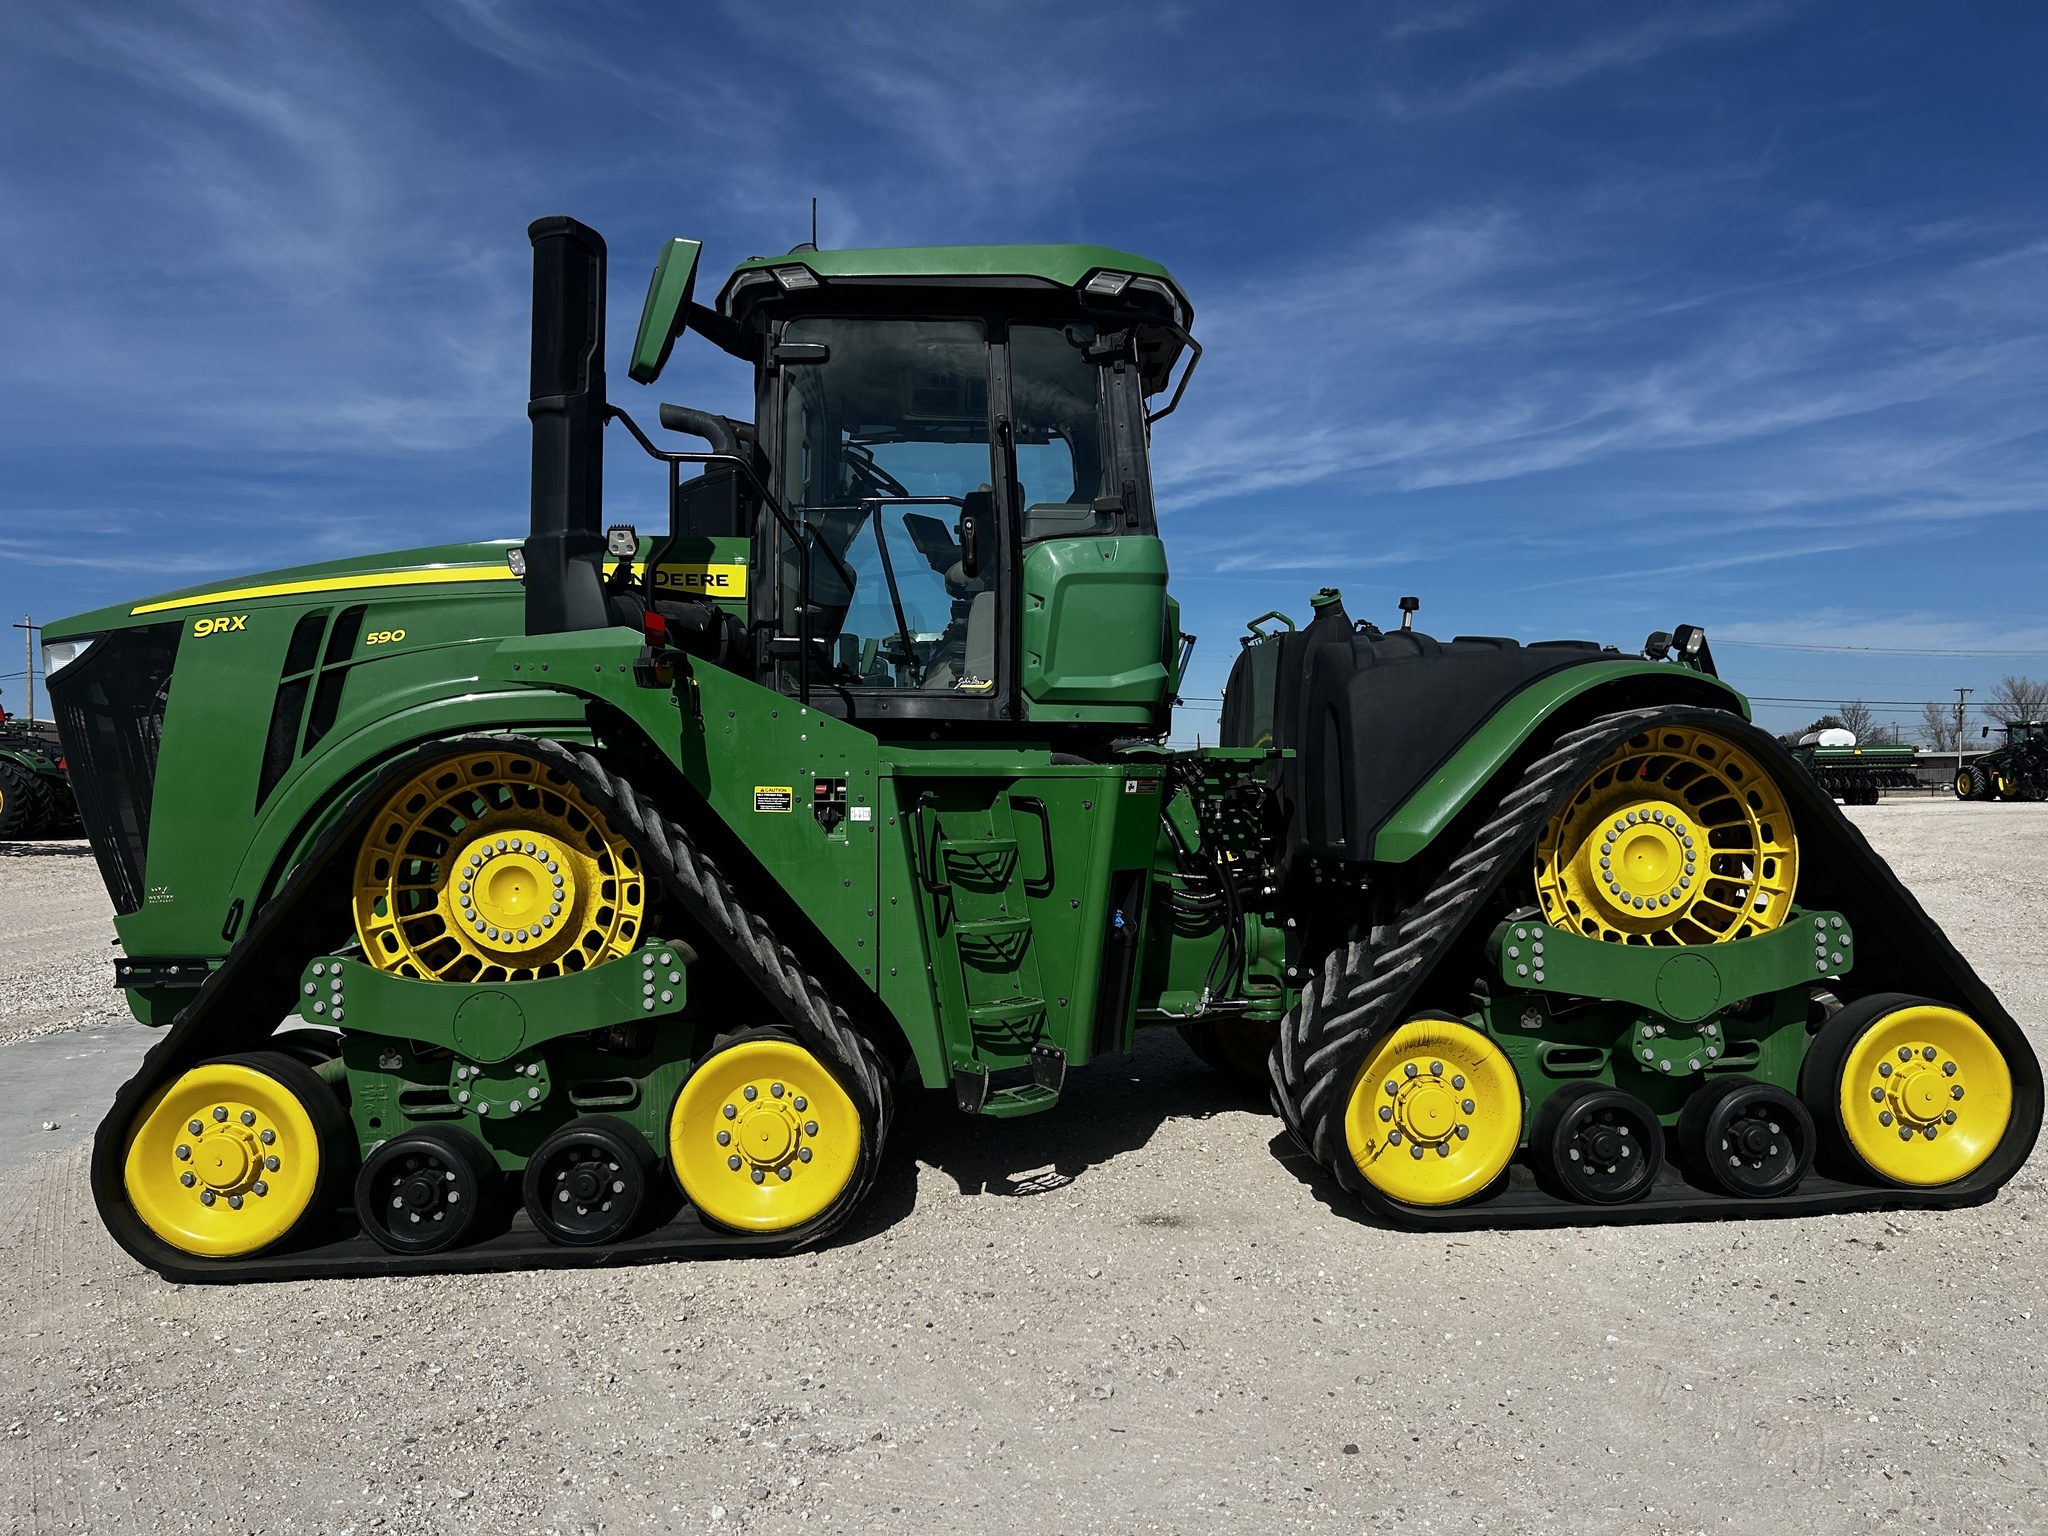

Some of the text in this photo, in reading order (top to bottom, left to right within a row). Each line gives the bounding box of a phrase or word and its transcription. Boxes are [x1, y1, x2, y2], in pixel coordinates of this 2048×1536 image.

[653, 570, 729, 587] DEERE
[193, 615, 248, 638] 9RX
[366, 629, 406, 645] 590
